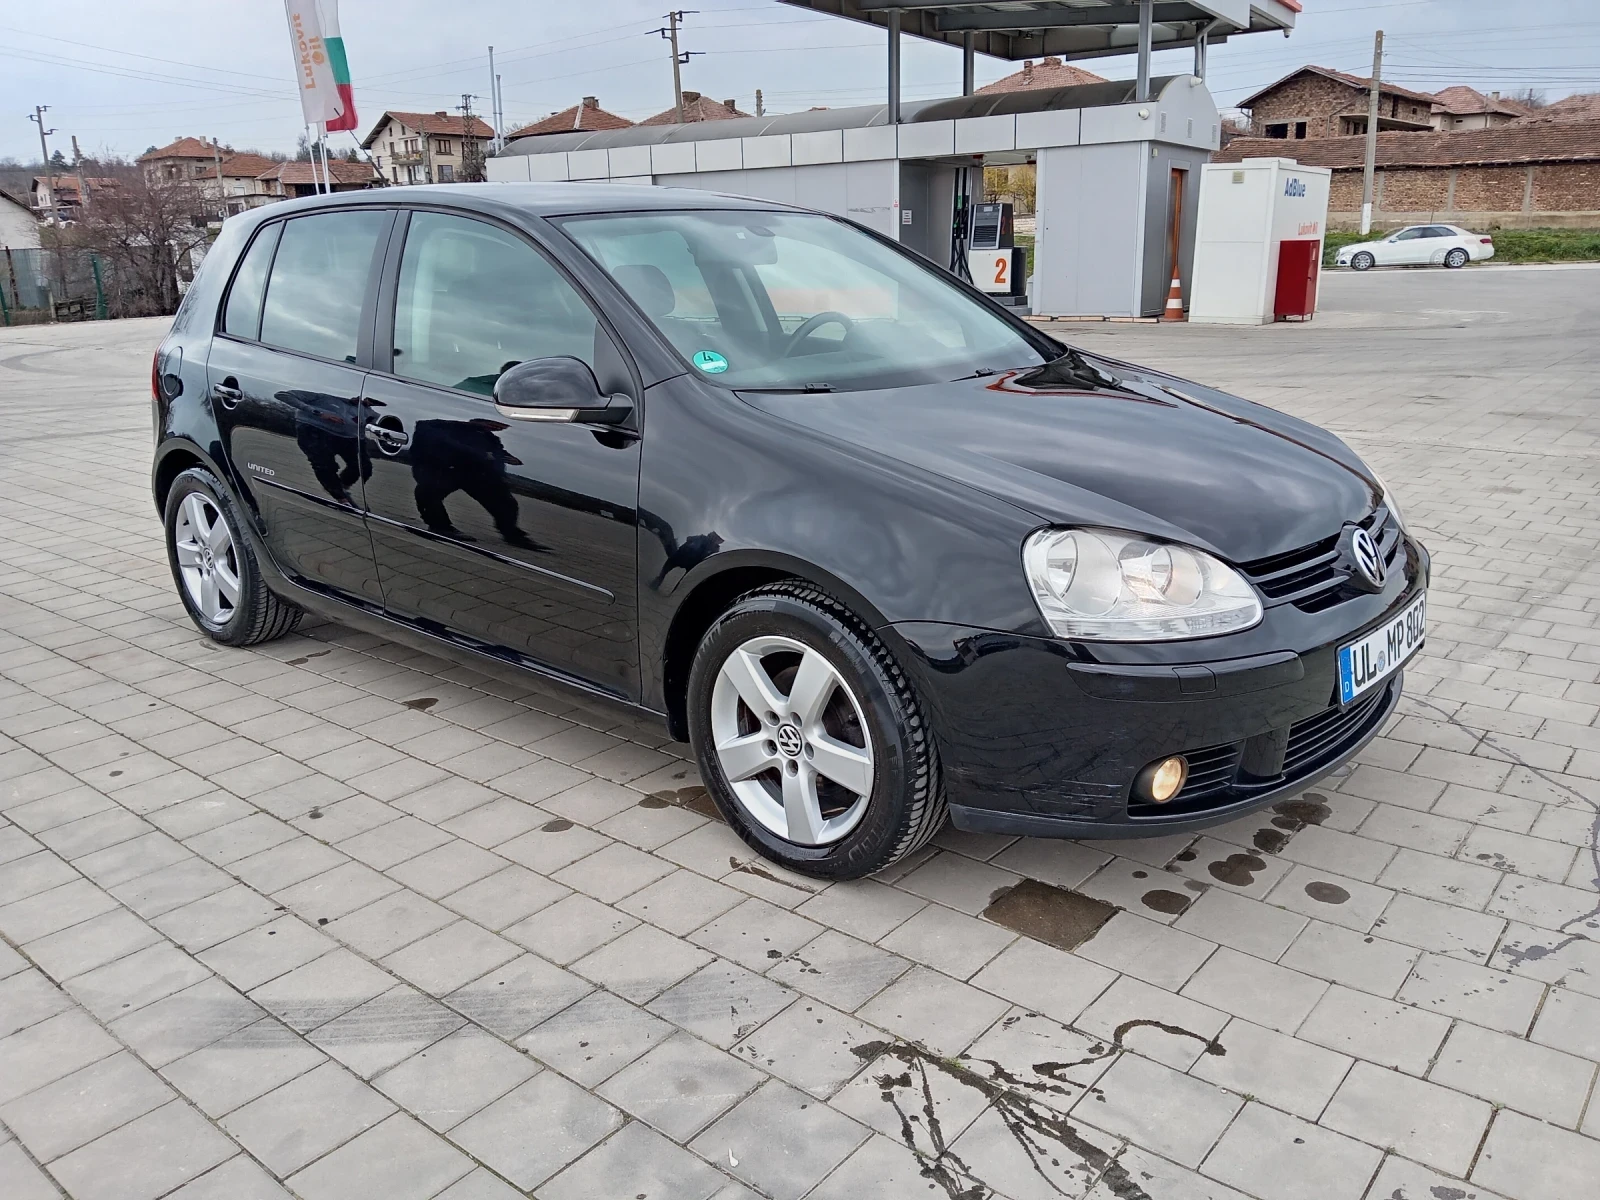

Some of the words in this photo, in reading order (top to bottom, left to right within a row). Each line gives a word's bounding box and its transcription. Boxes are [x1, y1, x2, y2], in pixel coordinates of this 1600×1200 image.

[293, 13, 316, 89] Lukovit
[1284, 178, 1306, 197] AdBlue
[994, 258, 1007, 283] 2
[702, 351, 713, 361] 4
[247, 462, 275, 476] UNITED
[1353, 643, 1377, 688] UL
[1387, 619, 1404, 667] MP
